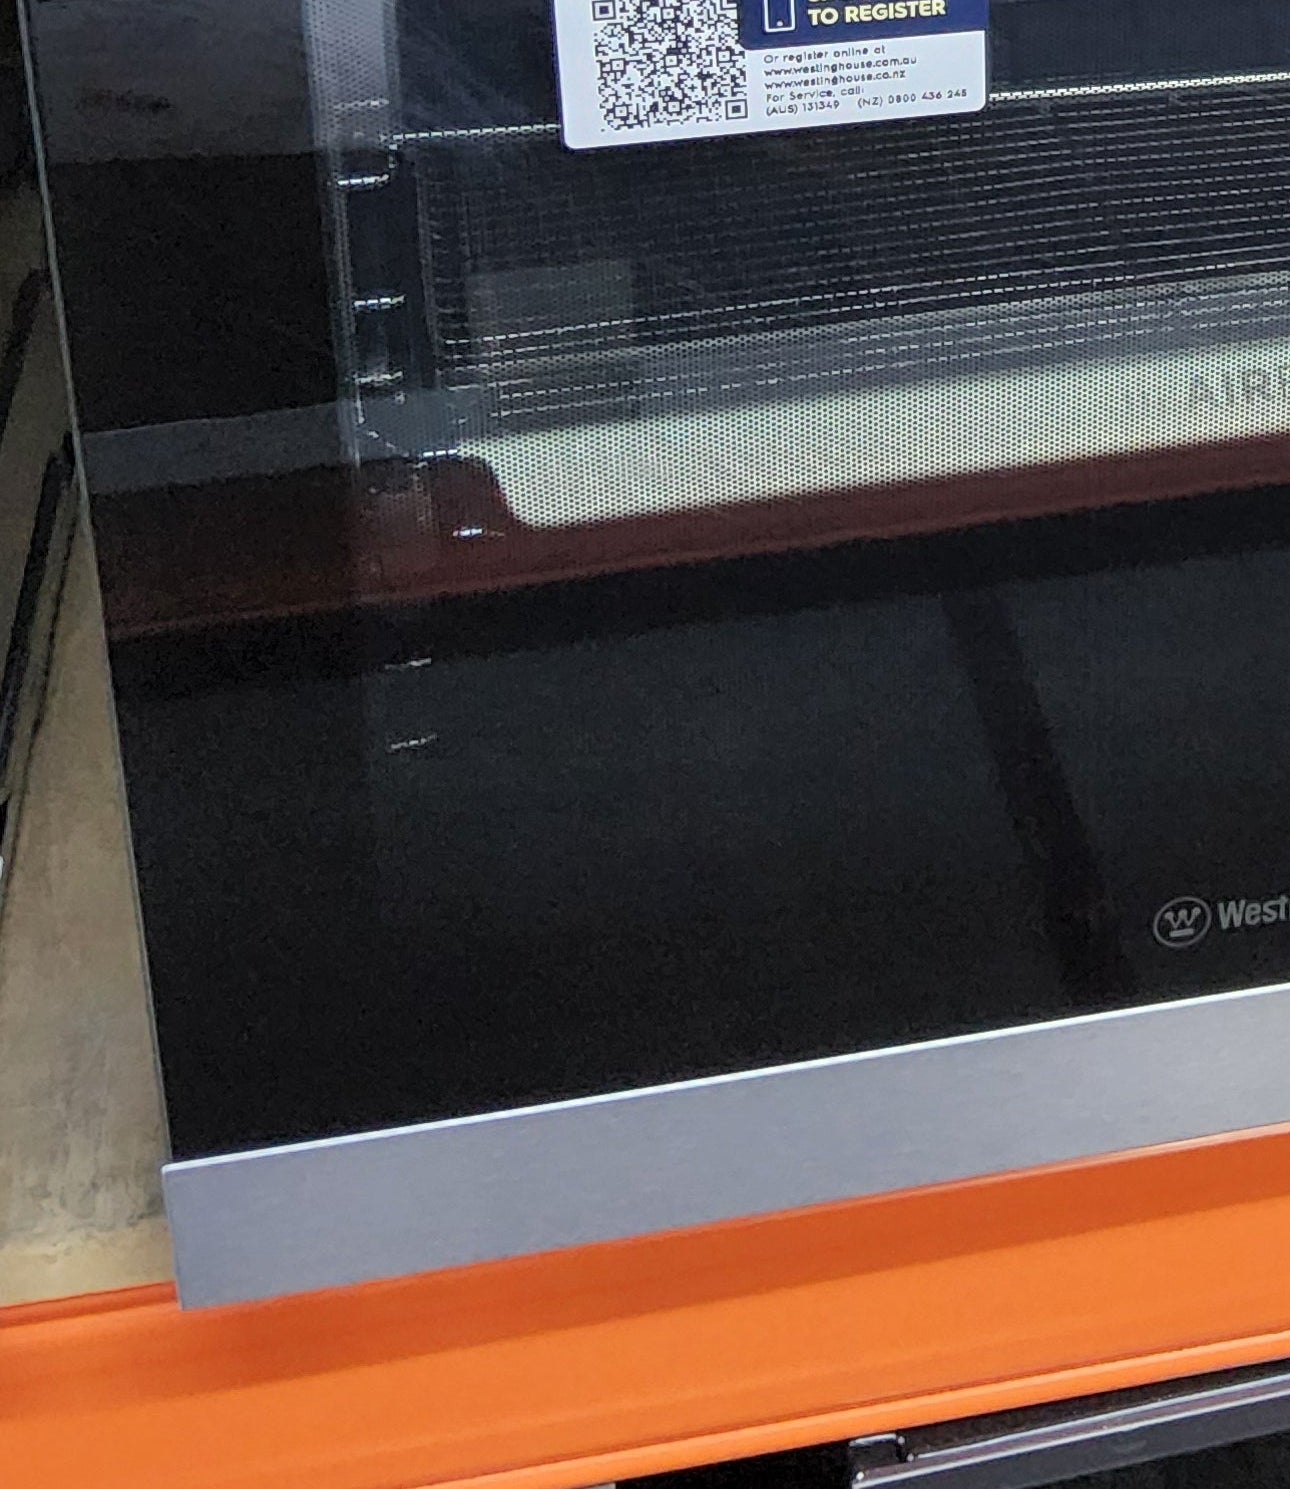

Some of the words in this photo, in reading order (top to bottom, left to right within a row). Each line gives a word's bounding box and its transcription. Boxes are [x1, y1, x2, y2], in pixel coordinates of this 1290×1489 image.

[807, 7, 839, 26] TO
[764, 54, 779, 63] Or
[783, 50, 828, 64] register
[833, 47, 869, 59] online
[874, 45, 885, 54] at
[764, 56, 917, 77] www.westinghouse.com.au
[764, 69, 906, 90] www.westinghouse.co.nz
[766, 93, 784, 103] For
[766, 104, 798, 116] (AUS)
[857, 97, 883, 109] (NZ)
